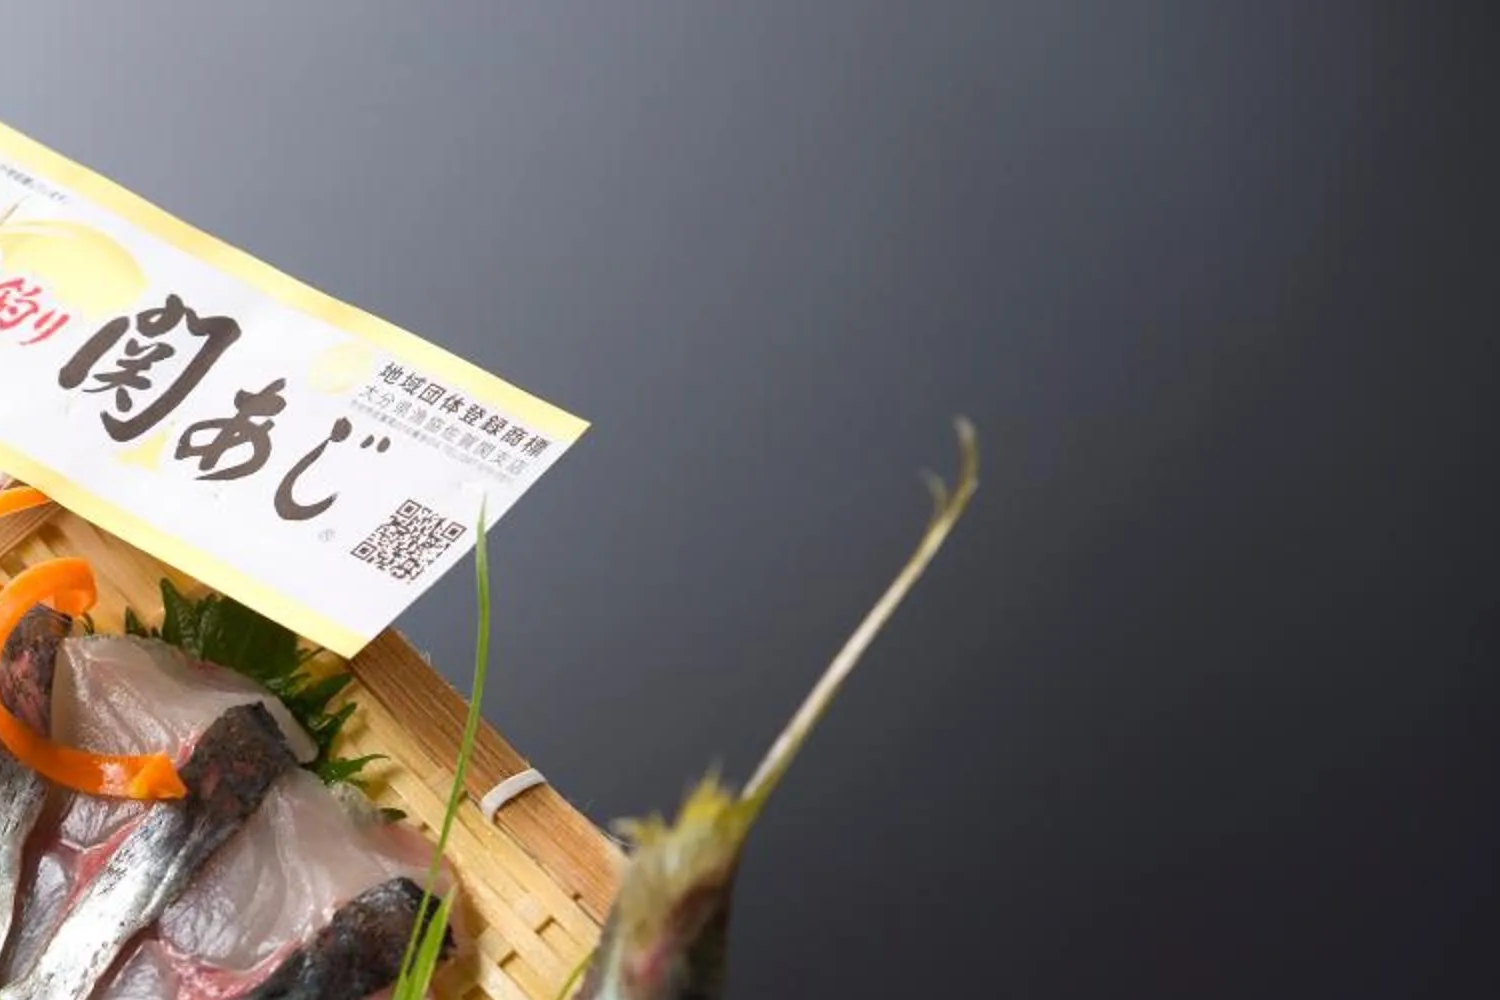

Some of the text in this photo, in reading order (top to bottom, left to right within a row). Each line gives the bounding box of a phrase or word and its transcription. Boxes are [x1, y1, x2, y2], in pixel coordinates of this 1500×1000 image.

[58, 294, 391, 521] 関あじ
[380, 362, 550, 457] 地域団体登録商標
